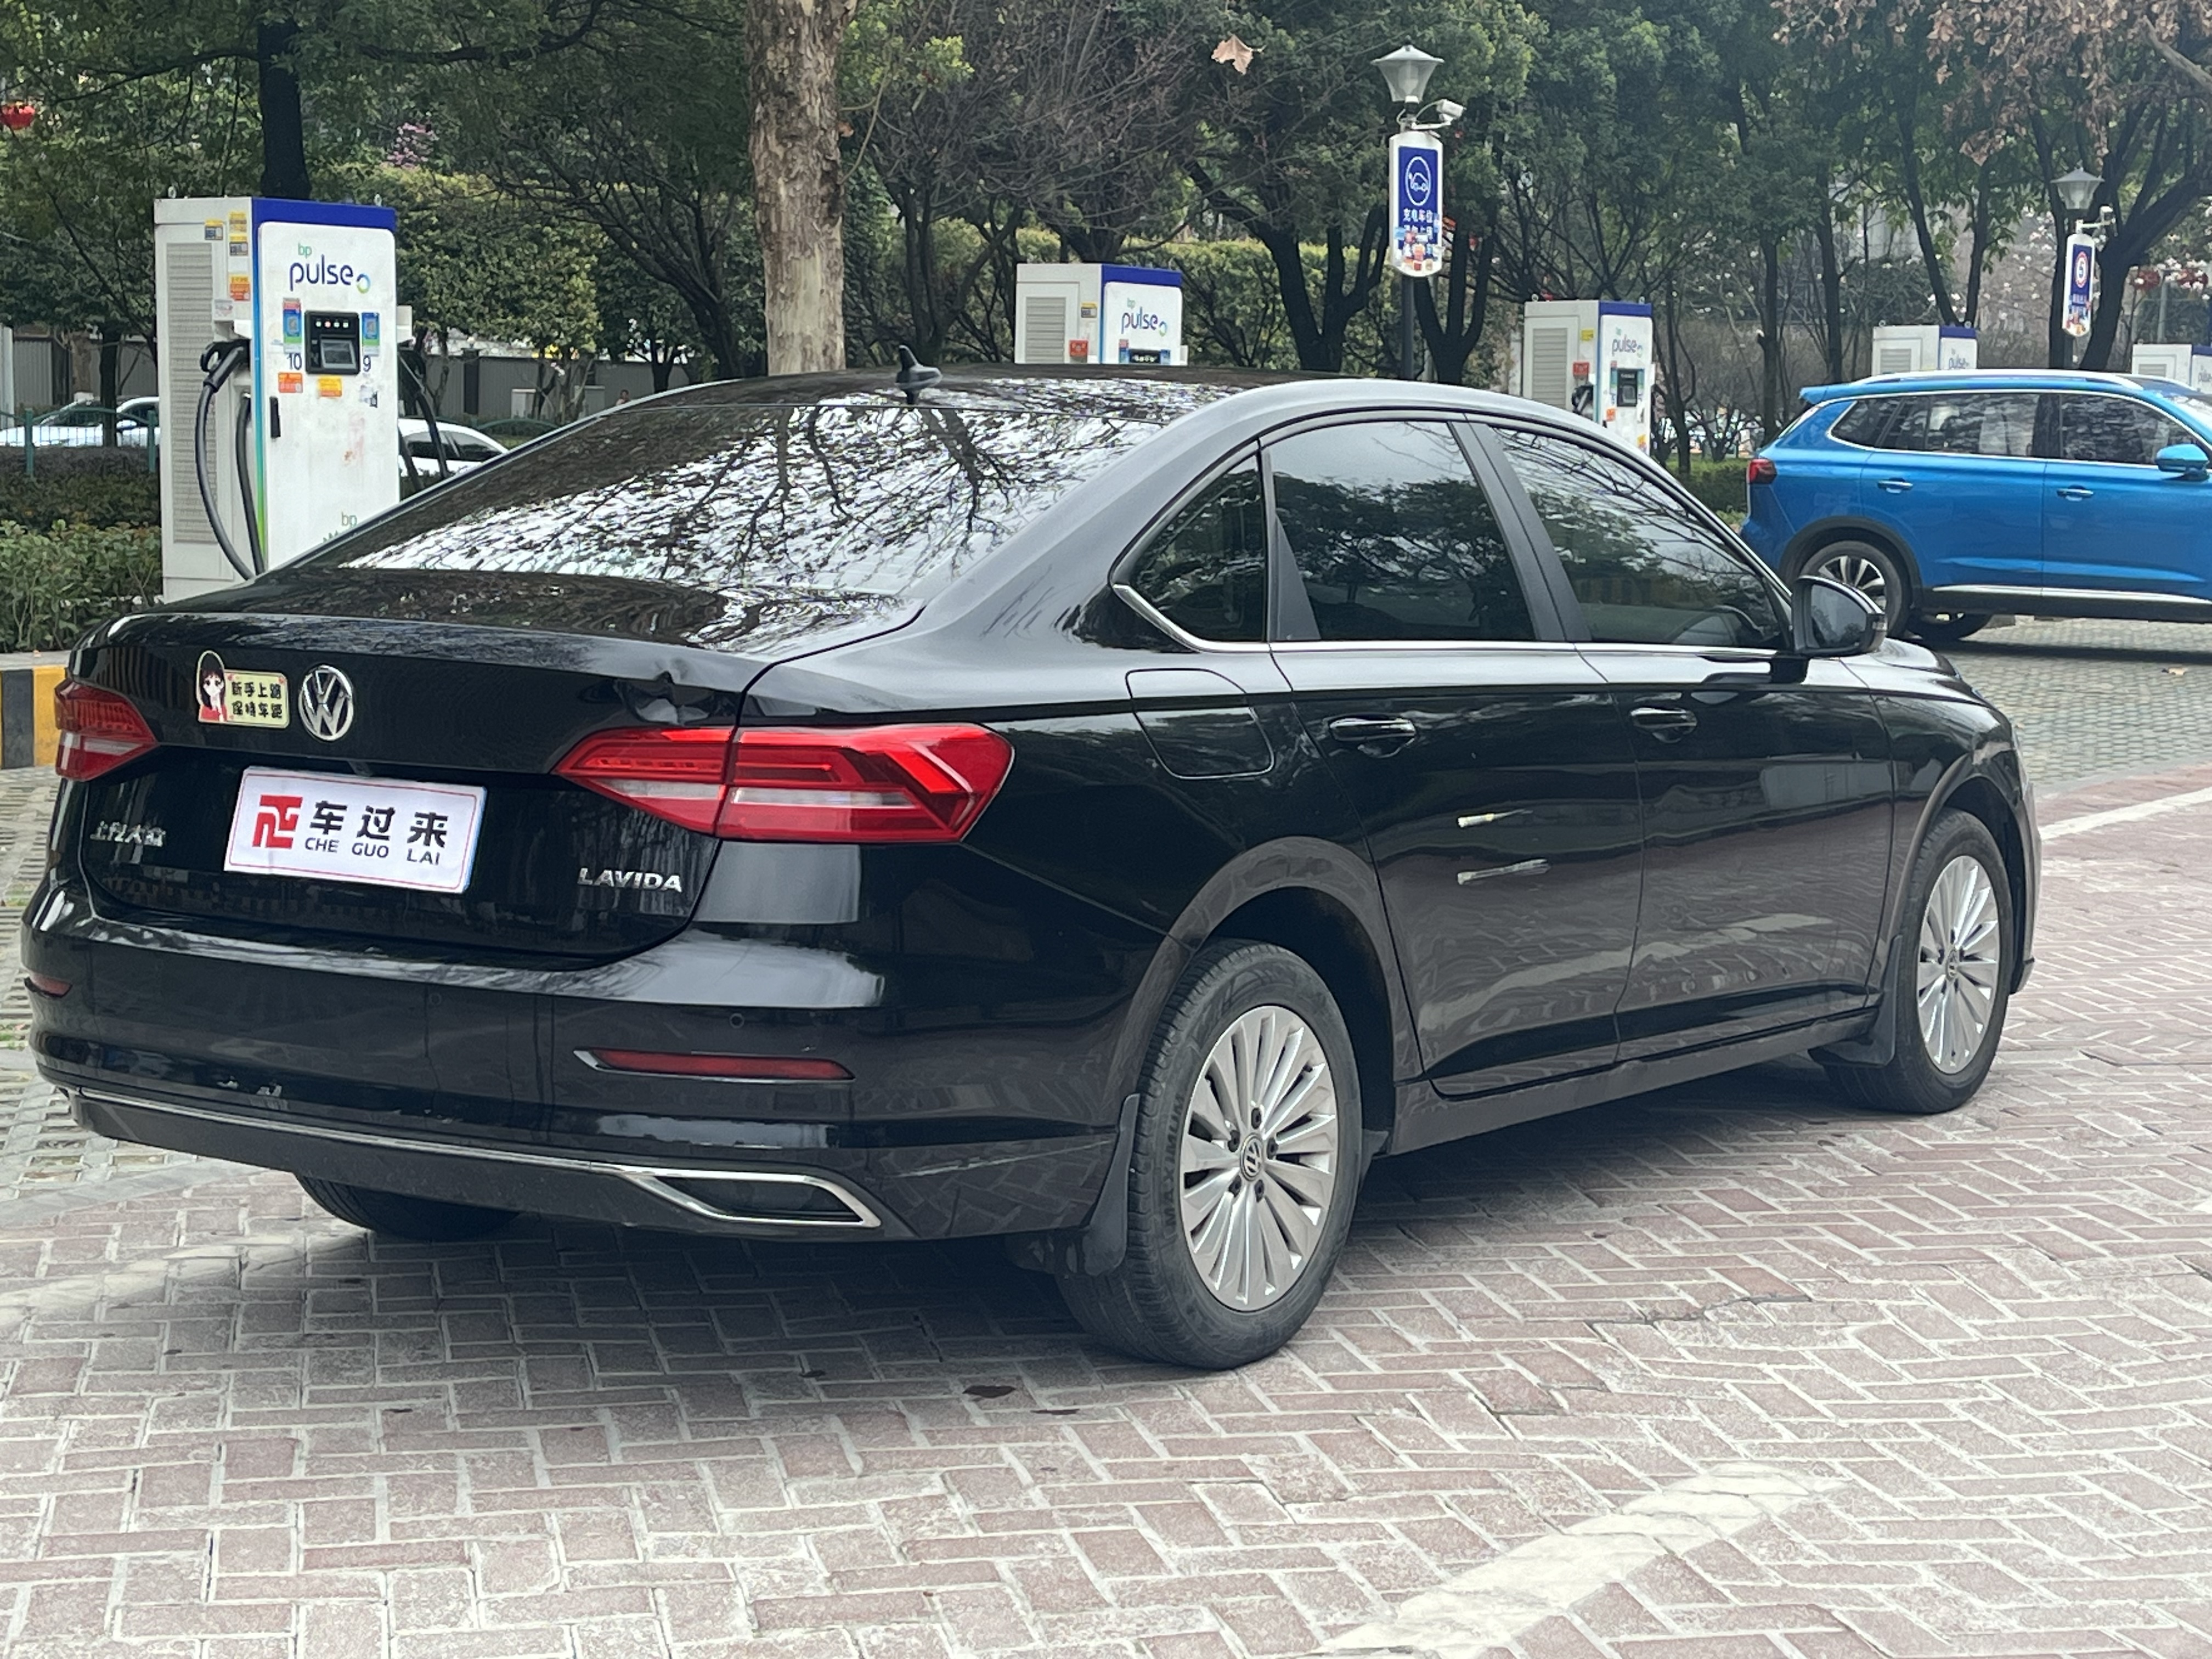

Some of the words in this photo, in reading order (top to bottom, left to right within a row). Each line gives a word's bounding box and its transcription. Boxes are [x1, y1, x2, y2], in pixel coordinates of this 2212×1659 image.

[231, 133, 281, 151] 新手上路
[232, 152, 283, 170] 保持车距
[298, 243, 312, 258] bp
[290, 255, 353, 291] pulse
[1121, 307, 1158, 334] pulse
[1612, 335, 1637, 357] pulse
[287, 353, 302, 370] 10
[363, 355, 371, 373] 9
[309, 800, 449, 848] 车过来
[304, 837, 340, 853] CHE
[352, 842, 389, 858] GUO
[407, 849, 440, 866] LAI
[577, 867, 682, 893] LAVIDA
